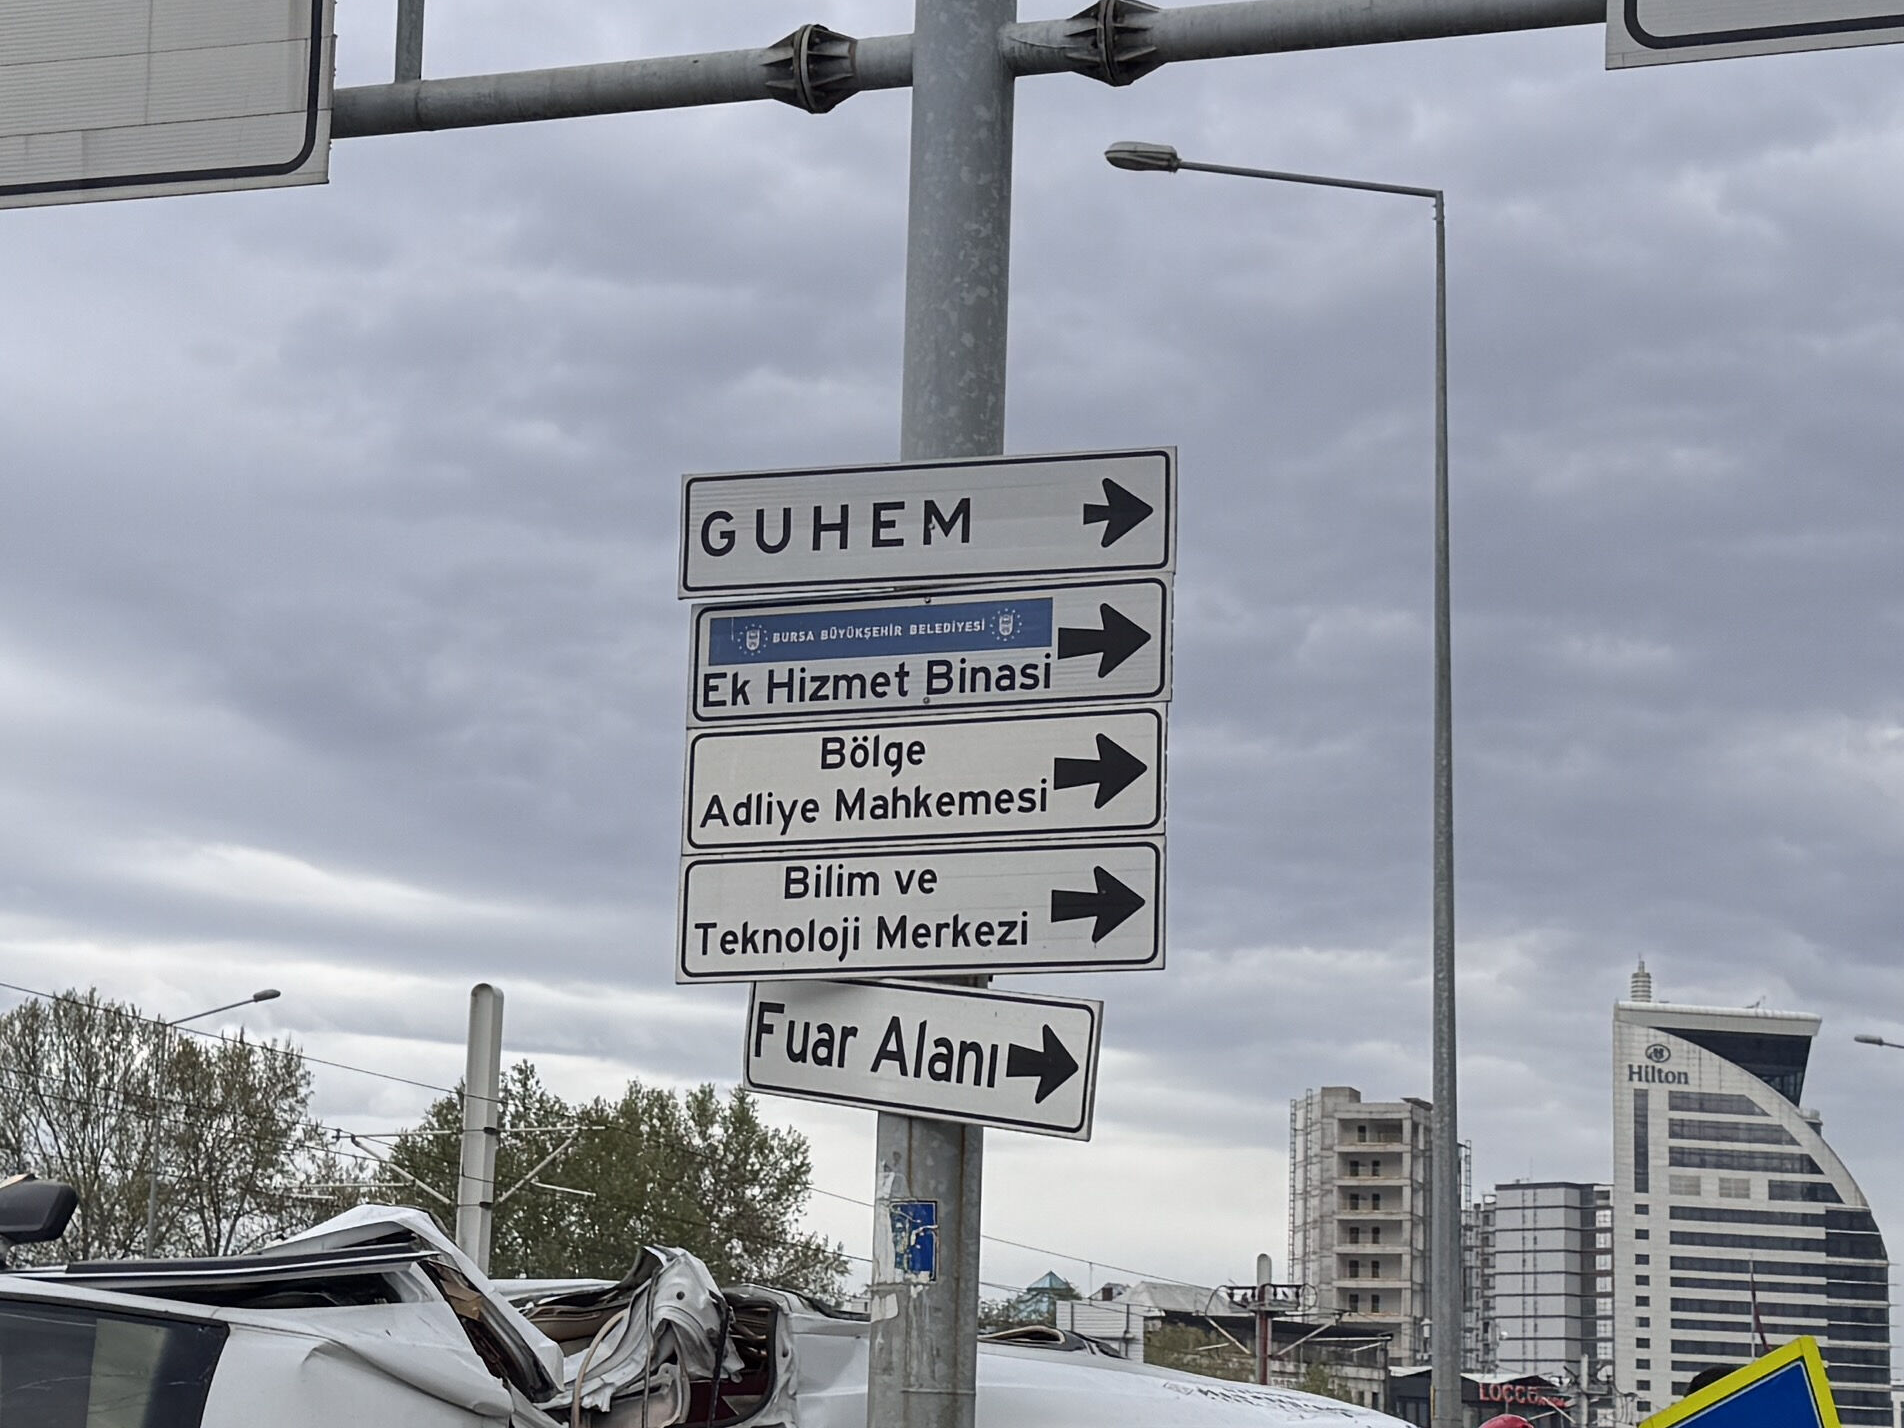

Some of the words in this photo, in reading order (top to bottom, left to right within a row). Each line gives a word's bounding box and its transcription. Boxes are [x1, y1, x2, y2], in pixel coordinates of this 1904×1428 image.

[700, 496, 971, 557] GUHEM
[772, 630, 815, 644] BURSA
[820, 623, 903, 641] BÜYÜKŞEHİR
[909, 617, 986, 636] BELEDİYESİ
[702, 671, 750, 708] Ek
[767, 660, 910, 705] Hizmet
[926, 652, 1052, 696] Binasi
[821, 735, 926, 777] Bölge
[700, 793, 820, 835] Adliye
[834, 778, 1047, 822] Mahkemesi
[784, 863, 880, 901] Bilim
[894, 867, 938, 896] ve
[694, 916, 861, 962] Teknoloji
[875, 911, 1029, 950] Merkezi
[753, 1001, 858, 1071] Fuar
[871, 1015, 998, 1089] Alanı
[1627, 1063, 1690, 1086] Hilton
